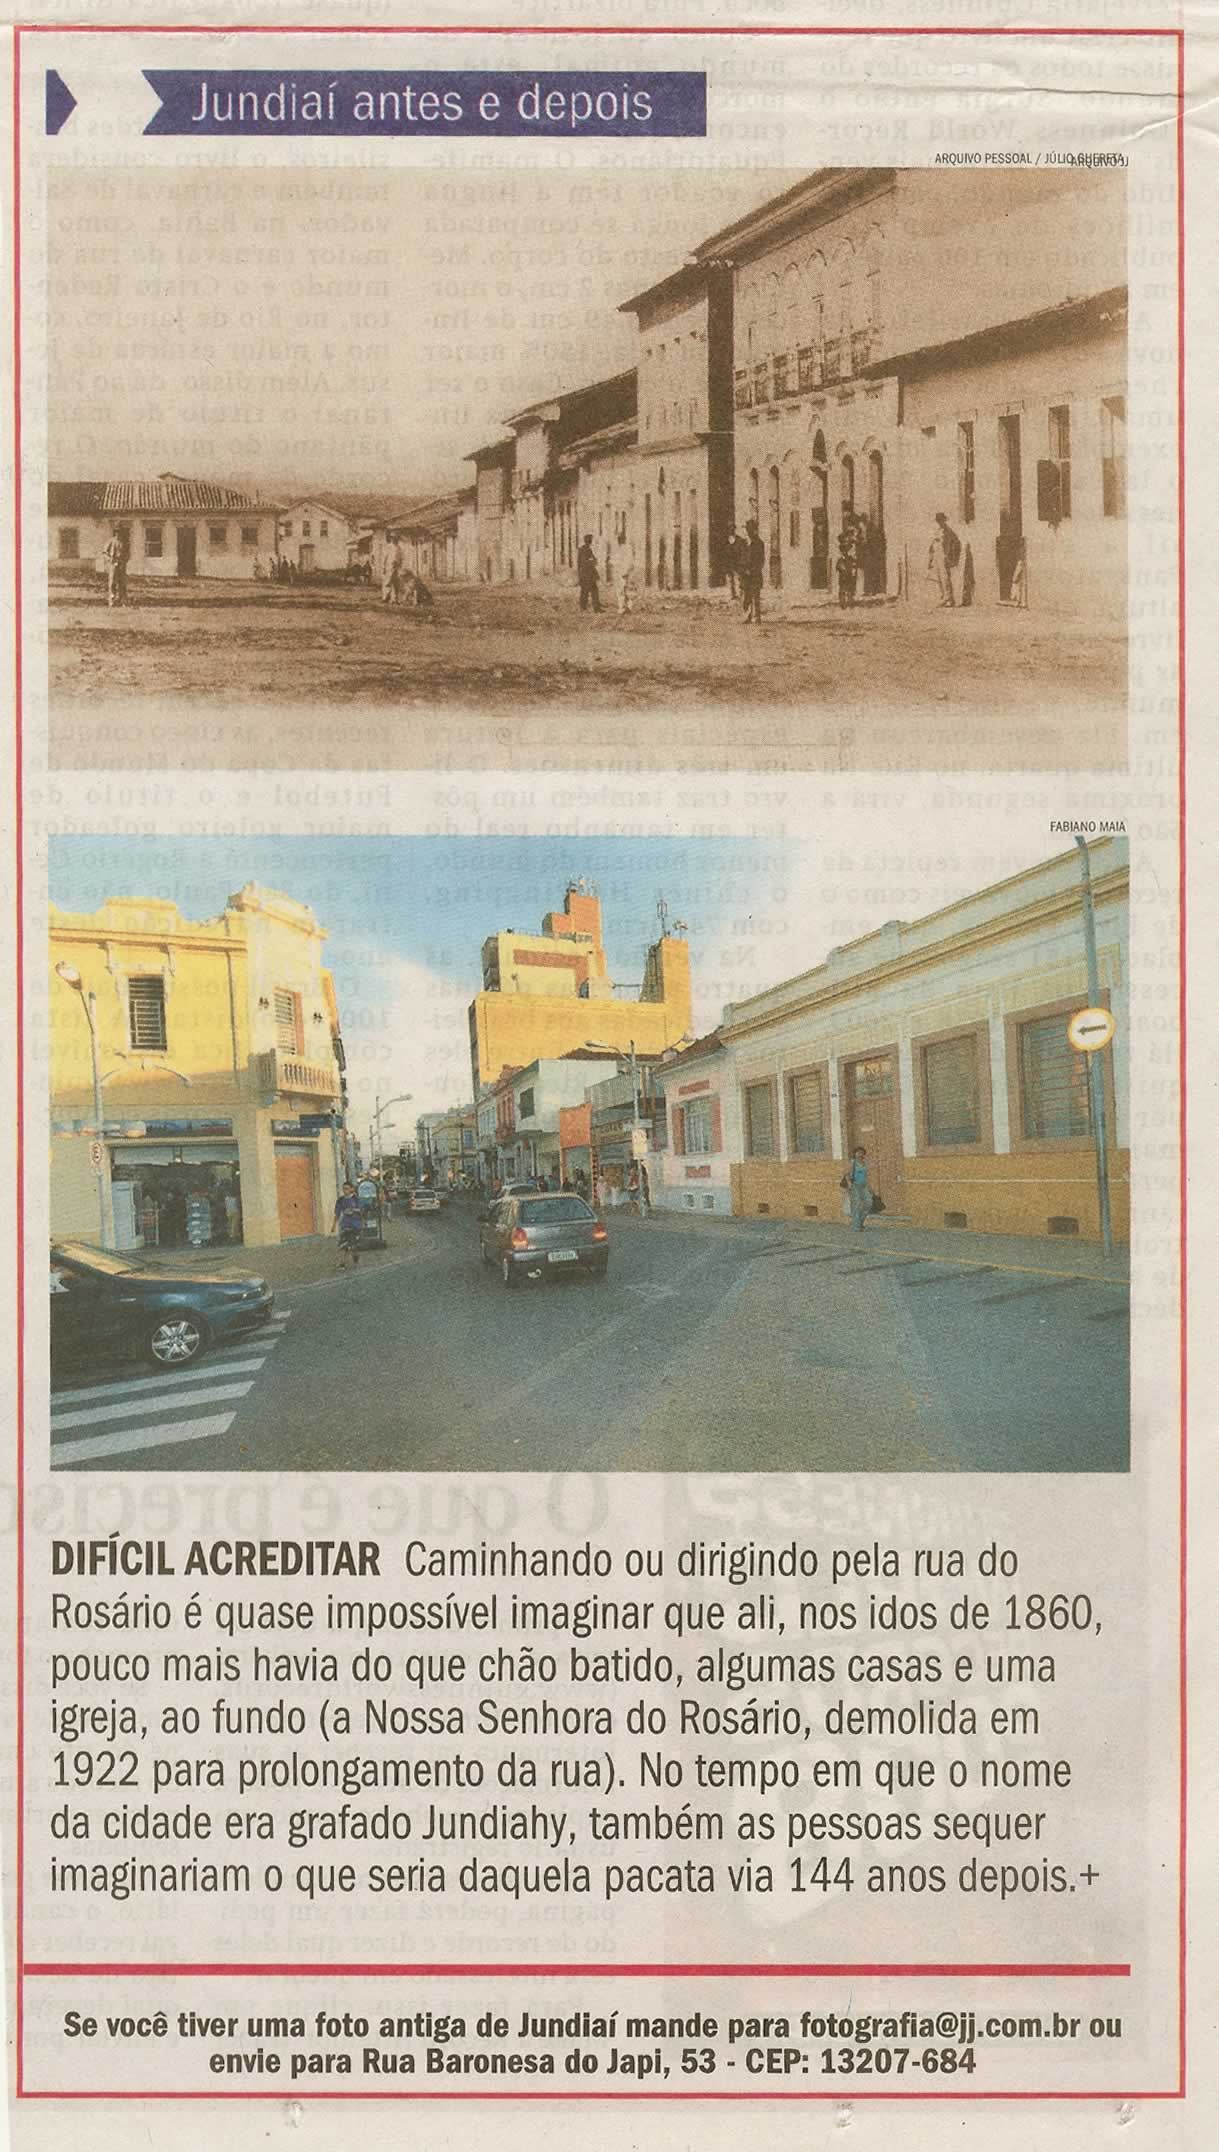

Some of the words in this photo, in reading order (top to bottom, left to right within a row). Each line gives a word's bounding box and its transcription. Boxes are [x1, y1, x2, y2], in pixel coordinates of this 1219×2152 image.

[192, 81, 338, 121] Jundiaí
[354, 86, 463, 120] antes
[479, 92, 500, 120] e
[518, 82, 652, 128] depois
[934, 152, 982, 165] ARQUIVO
[984, 152, 1032, 164] PESSOAL
[1050, 820, 1096, 832] FABIANO
[1099, 821, 1126, 832] MAIA
[53, 1531, 174, 1575] DIFÍCIL
[184, 1541, 380, 1576] ACREDITAR
[406, 1541, 611, 1576] Caminhando
[626, 1550, 662, 1576] ou
[678, 1542, 817, 1585] dirigindo
[833, 1542, 898, 1584] pela
[915, 1550, 963, 1576] rua
[979, 1542, 1017, 1576] do
[53, 1592, 170, 1628] Rosário
[185, 1592, 201, 1628] é
[216, 1602, 313, 1636] quase
[328, 1593, 496, 1636] impossível
[513, 1595, 654, 1638] imaginar
[665, 1603, 724, 1637] que
[738, 1595, 784, 1635] ali,
[801, 1603, 856, 1629] nos
[871, 1595, 937, 1629] idos
[951, 1595, 989, 1629] de
[1006, 1595, 1101, 1635] 1860,
[53, 1655, 149, 1688] pouco
[165, 1647, 240, 1681] mais
[255, 1647, 337, 1681] havia
[353, 1647, 391, 1681] do
[406, 1656, 465, 1689] que
[480, 1647, 556, 1681] chão
[571, 1648, 682, 1687] batido,
[697, 1648, 834, 1690] algumas
[848, 1656, 942, 1682] casas
[956, 1656, 972, 1682] e
[987, 1656, 1054, 1682] uma
[52, 1699, 146, 1742] igreja,
[162, 1708, 199, 1733] ao
[213, 1699, 305, 1734] fundo
[320, 1700, 350, 1741] (a
[367, 1700, 463, 1734] Nossa
[478, 1699, 611, 1734] Senhora
[627, 1700, 665, 1734] do
[681, 1698, 810, 1740] Rosário,
[826, 1700, 976, 1734] demolida
[992, 1708, 1038, 1734] em
[55, 1751, 138, 1786] 1922
[155, 1760, 224, 1794] para
[240, 1752, 483, 1795] prolongamento
[498, 1752, 536, 1786] da
[552, 1752, 624, 1794] rua).
[641, 1752, 682, 1787] No
[695, 1755, 798, 1794] tempo
[814, 1760, 860, 1787] em
[876, 1761, 934, 1794] que
[950, 1761, 967, 1787] o
[982, 1760, 1070, 1787] nome
[51, 1805, 89, 1838] da
[104, 1805, 211, 1839] cidade
[226, 1813, 273, 1839] era
[289, 1804, 410, 1847] grafado
[423, 1805, 575, 1848] Jundiahy,
[589, 1803, 722, 1840] também
[738, 1813, 774, 1840] as
[789, 1814, 921, 1847] pessoas
[934, 1813, 1045, 1847] sequer
[52, 1857, 249, 1900] imaginariam
[265, 1866, 282, 1891] o
[297, 1865, 355, 1899] que
[369, 1858, 444, 1892] seria
[460, 1857, 590, 1899] daquela
[606, 1861, 714, 1900] pacata
[728, 1858, 772, 1892] via
[791, 1857, 854, 1891] 144
[868, 1866, 945, 1892] anos
[64, 2012, 97, 2037] Se
[107, 2011, 167, 2037] você
[178, 2012, 238, 2037] tiver
[248, 2018, 304, 2037] uma
[316, 2012, 368, 2037] foto
[380, 2012, 465, 2043] antiga
[477, 2012, 508, 2037] de
[518, 2011, 618, 2037] Jundiaí
[627, 2013, 718, 2037] mande
[729, 2018, 789, 2043] para
[801, 2012, 1080, 2043] fotografia@jj.com.br
[1090, 2019, 1121, 2037] ou
[210, 2048, 280, 2073] envie
[292, 2054, 351, 2079] para
[364, 2048, 414, 2073] Rua
[427, 2048, 554, 2073] Baronesa
[565, 2049, 598, 2073] do
[607, 2048, 669, 2079] Japi,
[681, 2048, 715, 2073] 53
[746, 2049, 808, 2073] CEP:
[822, 2048, 976, 2073] 13207-684
